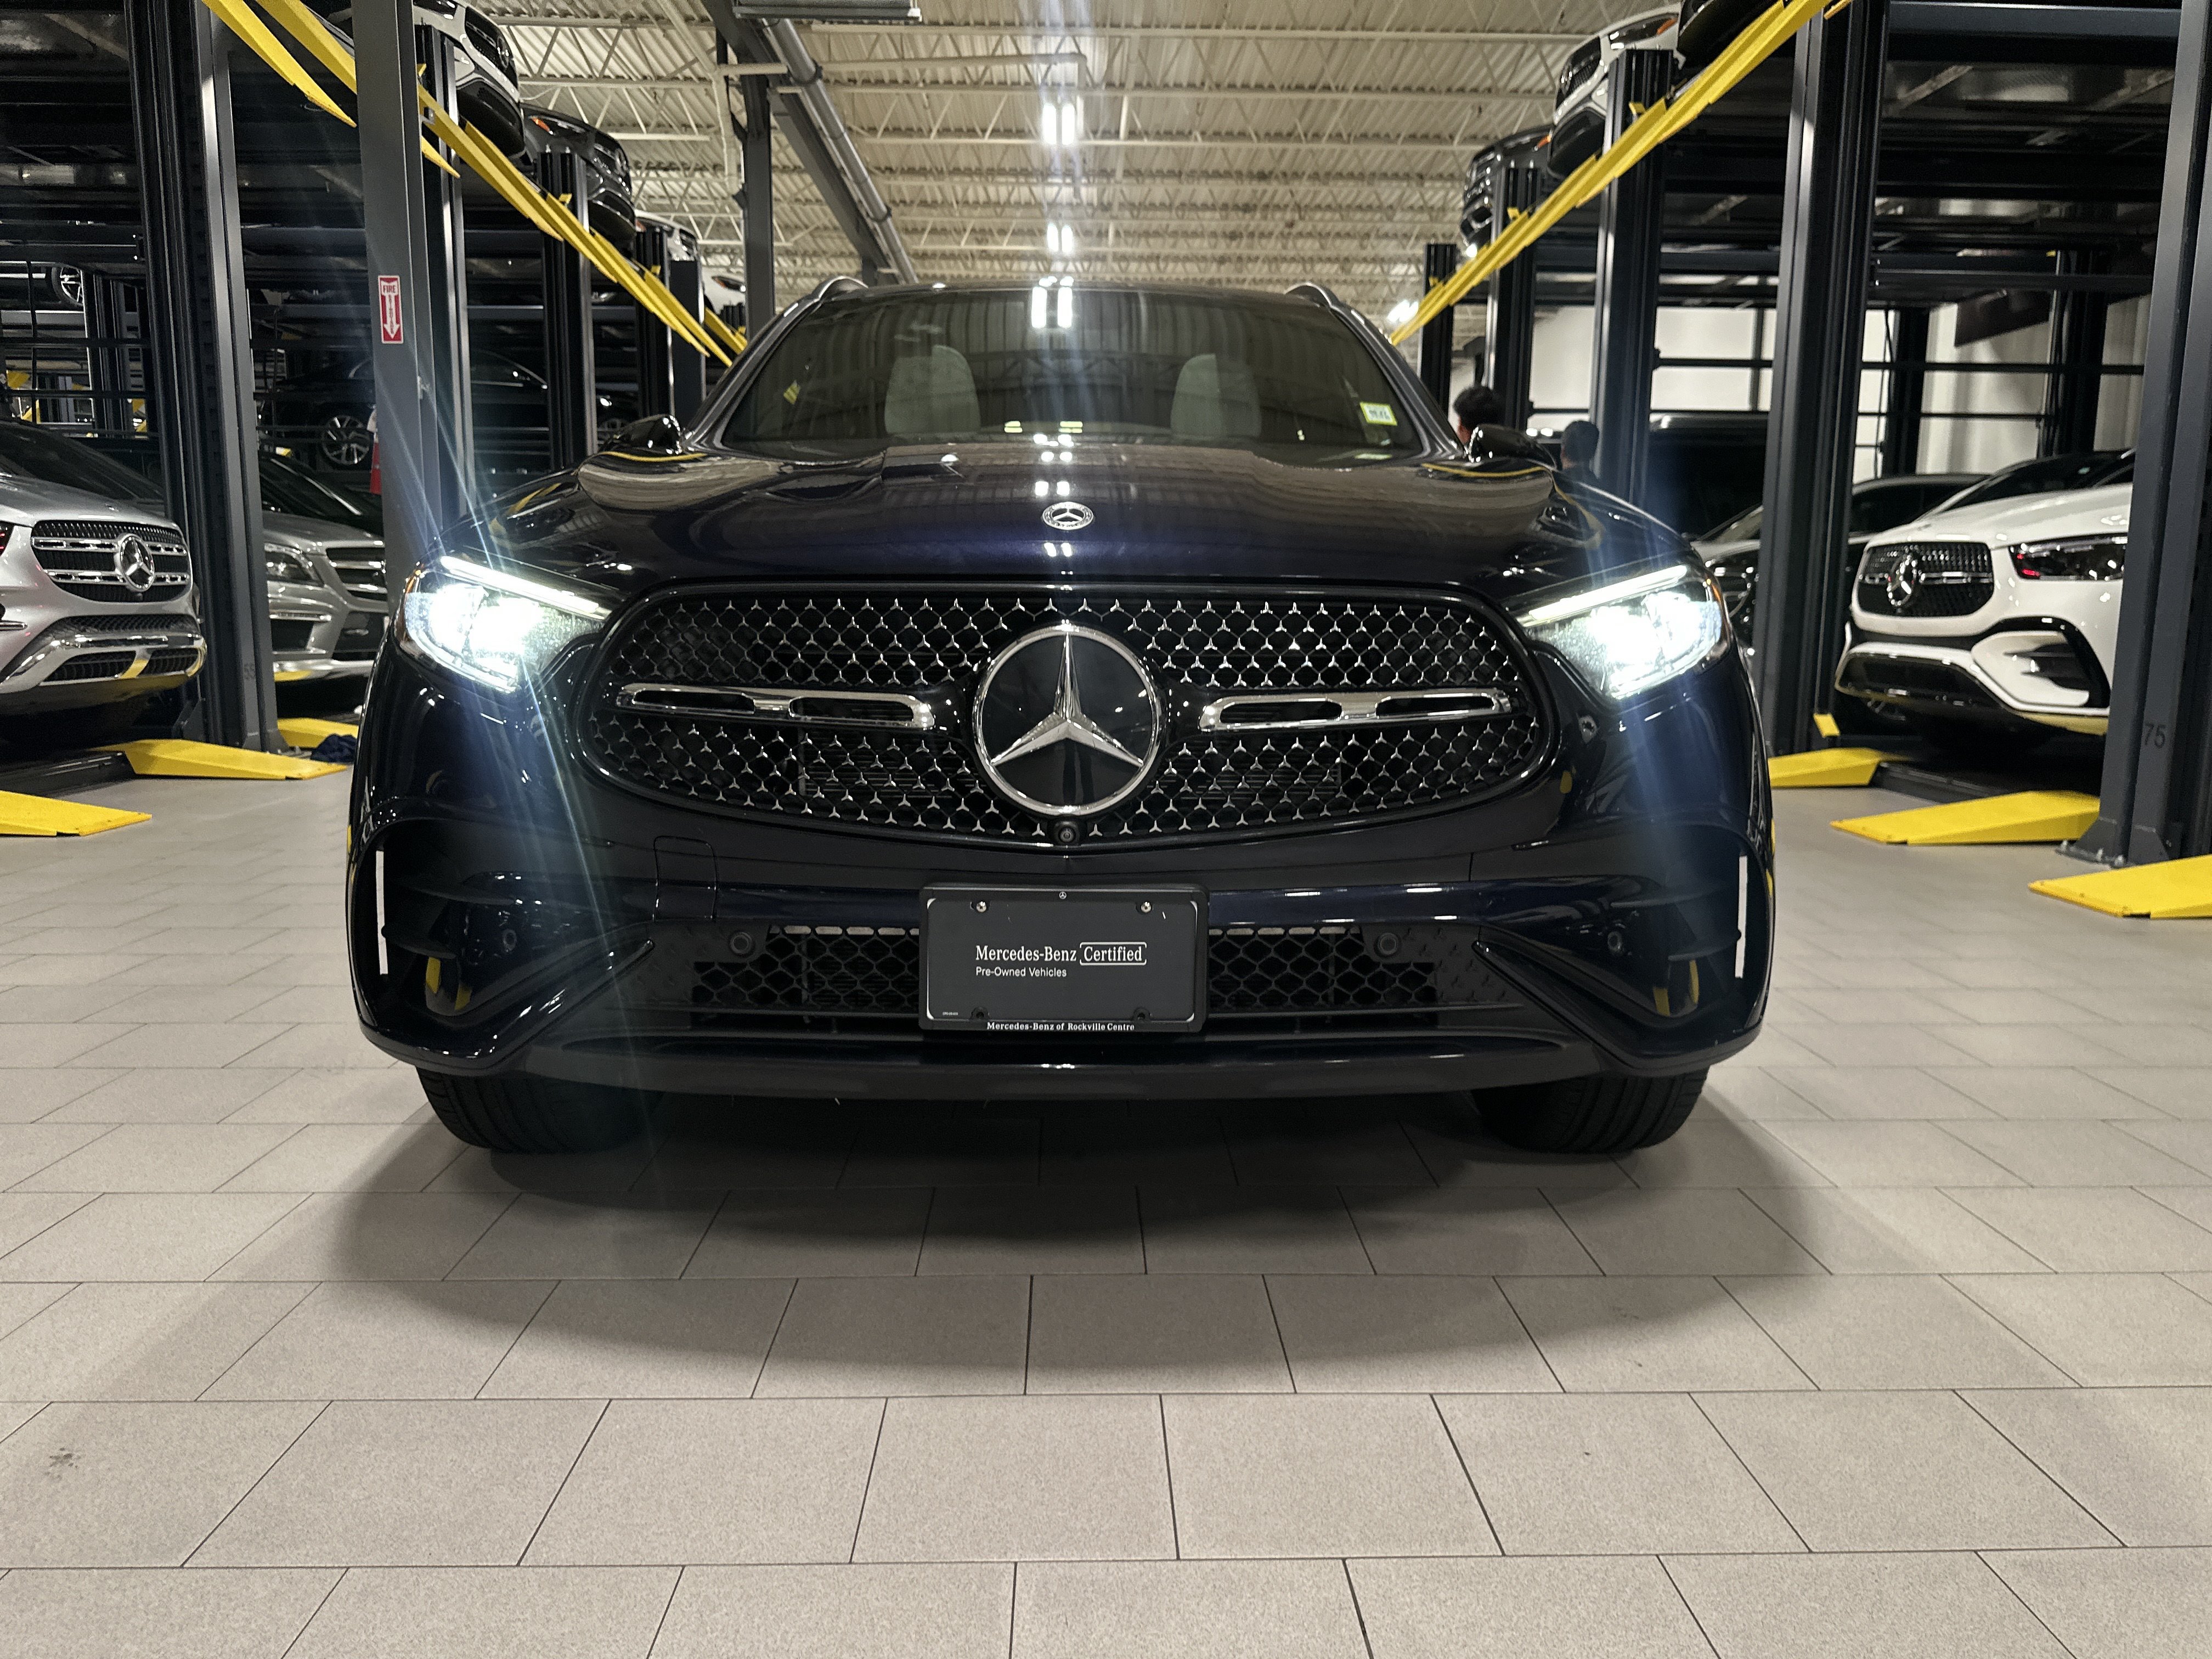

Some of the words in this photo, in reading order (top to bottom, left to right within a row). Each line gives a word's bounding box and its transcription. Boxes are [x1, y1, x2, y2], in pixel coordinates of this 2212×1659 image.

[382, 285, 396, 294] FIRE
[2145, 723, 2166, 749] 75
[975, 945, 1077, 962] Mercedes-Benz
[1084, 946, 1142, 962] Certified
[975, 966, 1026, 977] Pre-Owned
[1029, 967, 1067, 978] Vehicles
[987, 1022, 1054, 1031] Mercedes-Benz
[1056, 1023, 1064, 1031] of
[1068, 1023, 1105, 1031] Rockville
[1107, 1023, 1135, 1031] Centre
